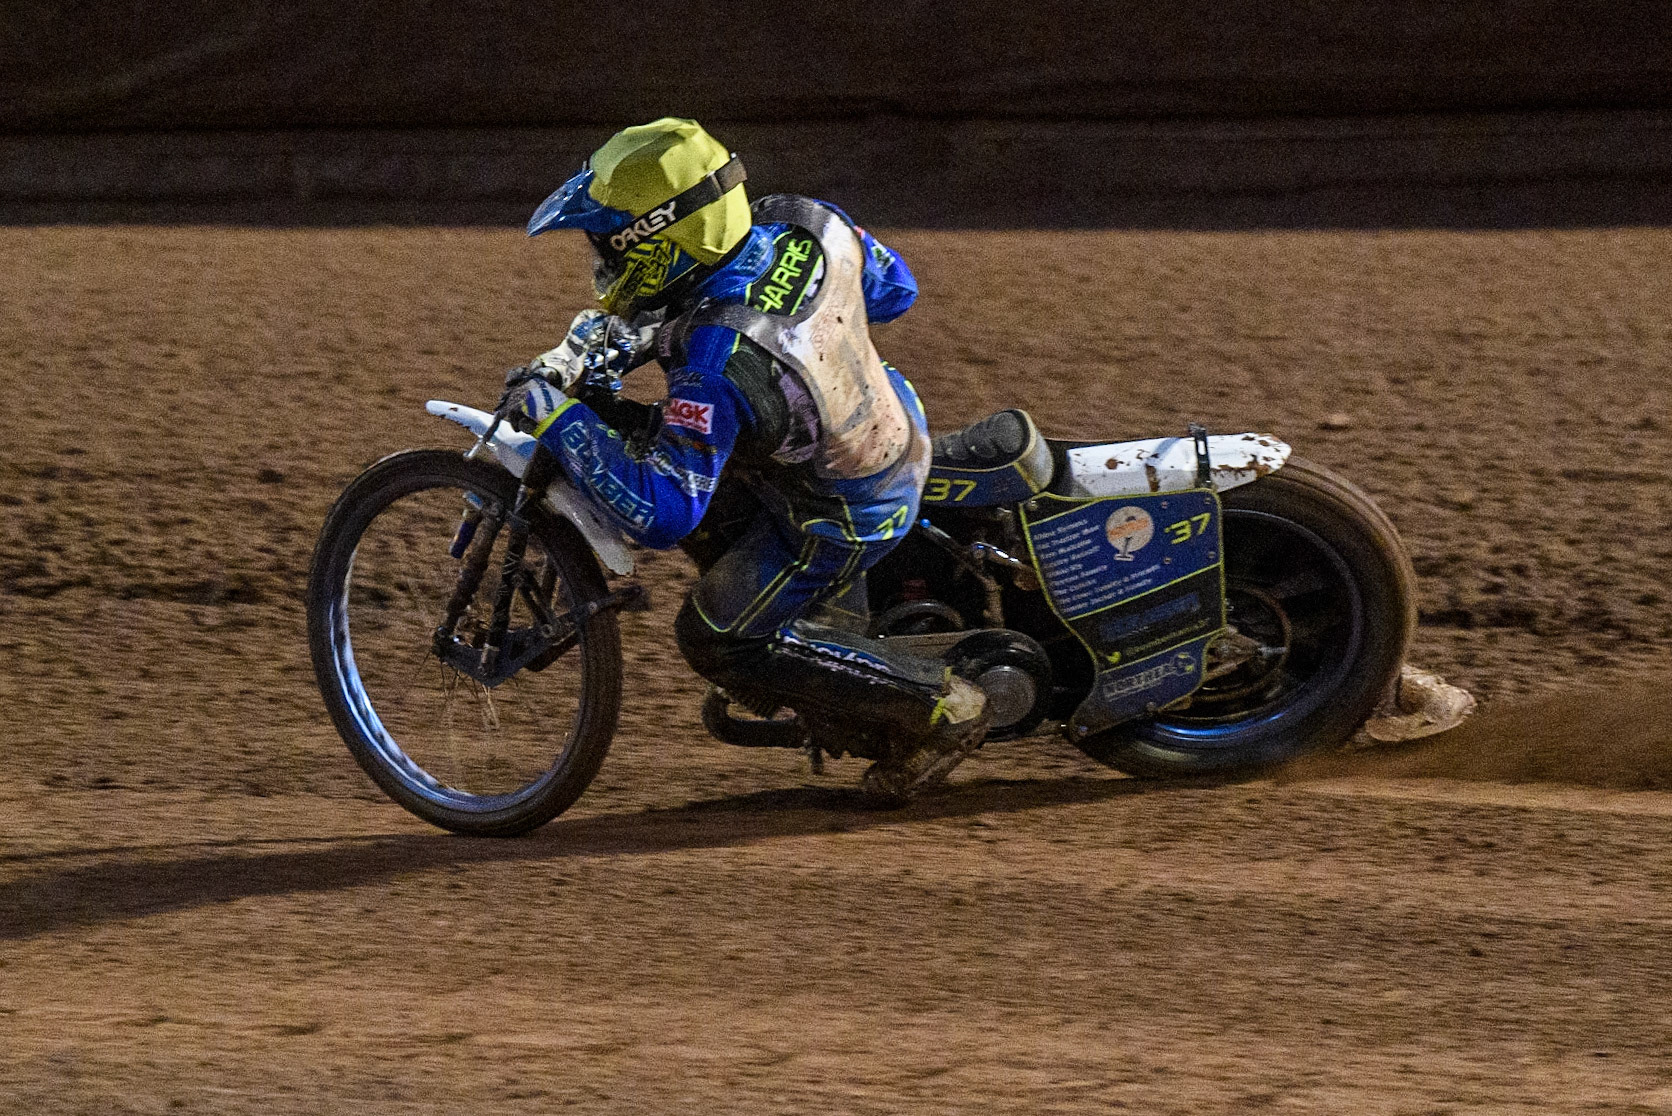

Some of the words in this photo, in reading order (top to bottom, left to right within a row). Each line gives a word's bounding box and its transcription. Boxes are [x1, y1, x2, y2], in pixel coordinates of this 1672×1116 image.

[610, 201, 676, 251] OAKLEY
[754, 239, 813, 313] HARRIS
[924, 478, 977, 501] 37
[1164, 512, 1211, 545] 37
